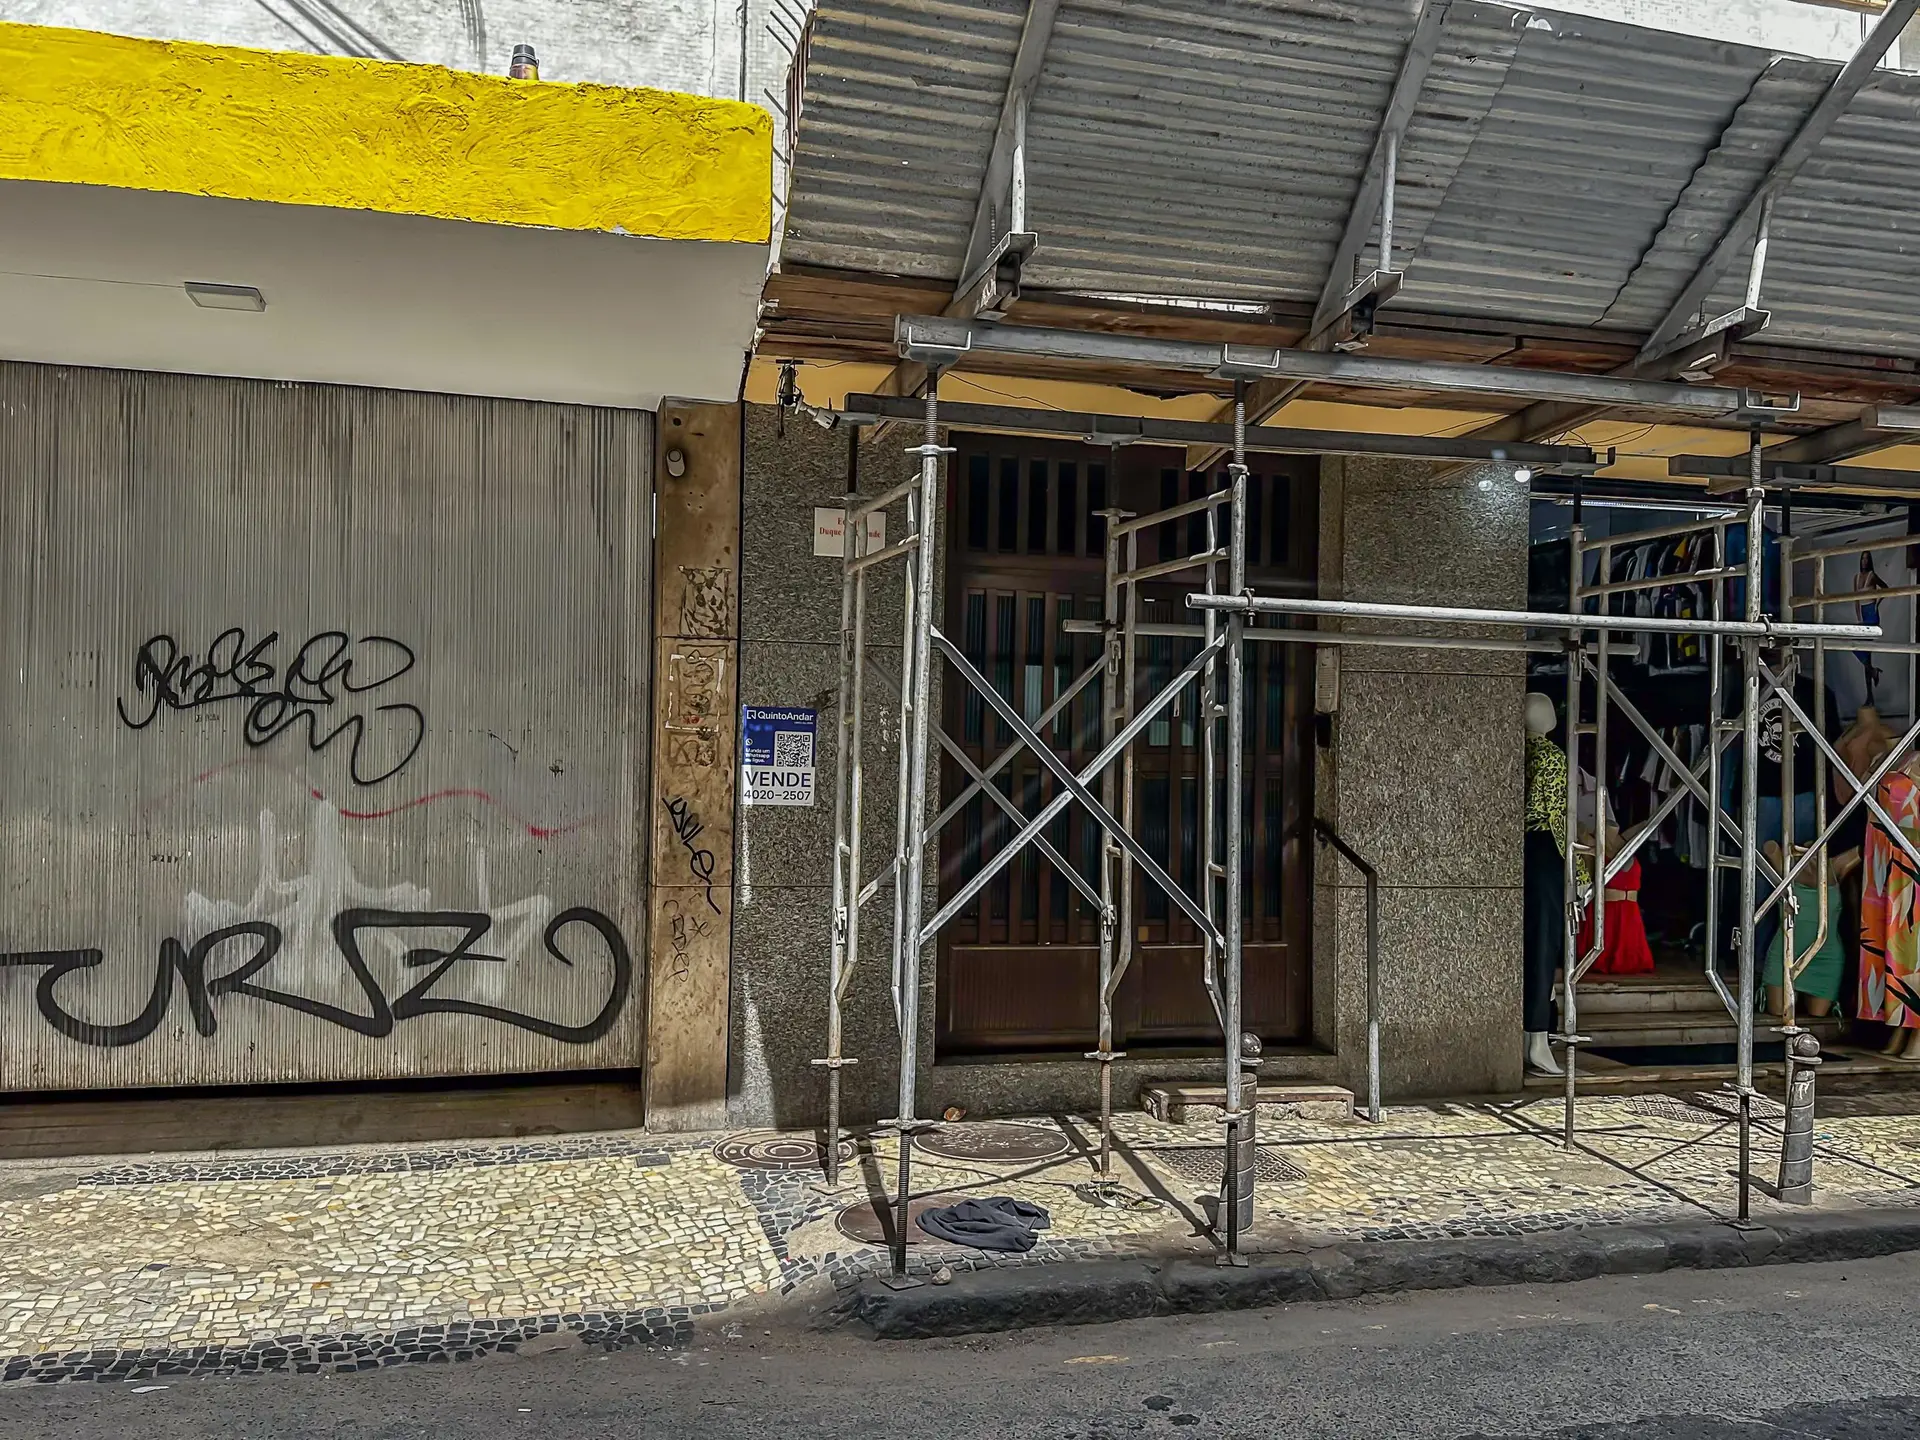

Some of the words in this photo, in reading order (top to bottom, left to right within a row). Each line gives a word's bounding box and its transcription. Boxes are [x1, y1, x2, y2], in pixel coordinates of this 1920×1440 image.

[820, 527, 841, 537] Duque
[757, 710, 814, 721] QuintoAndar
[745, 771, 811, 787] VENDE
[744, 790, 811, 800] 4020-2507
